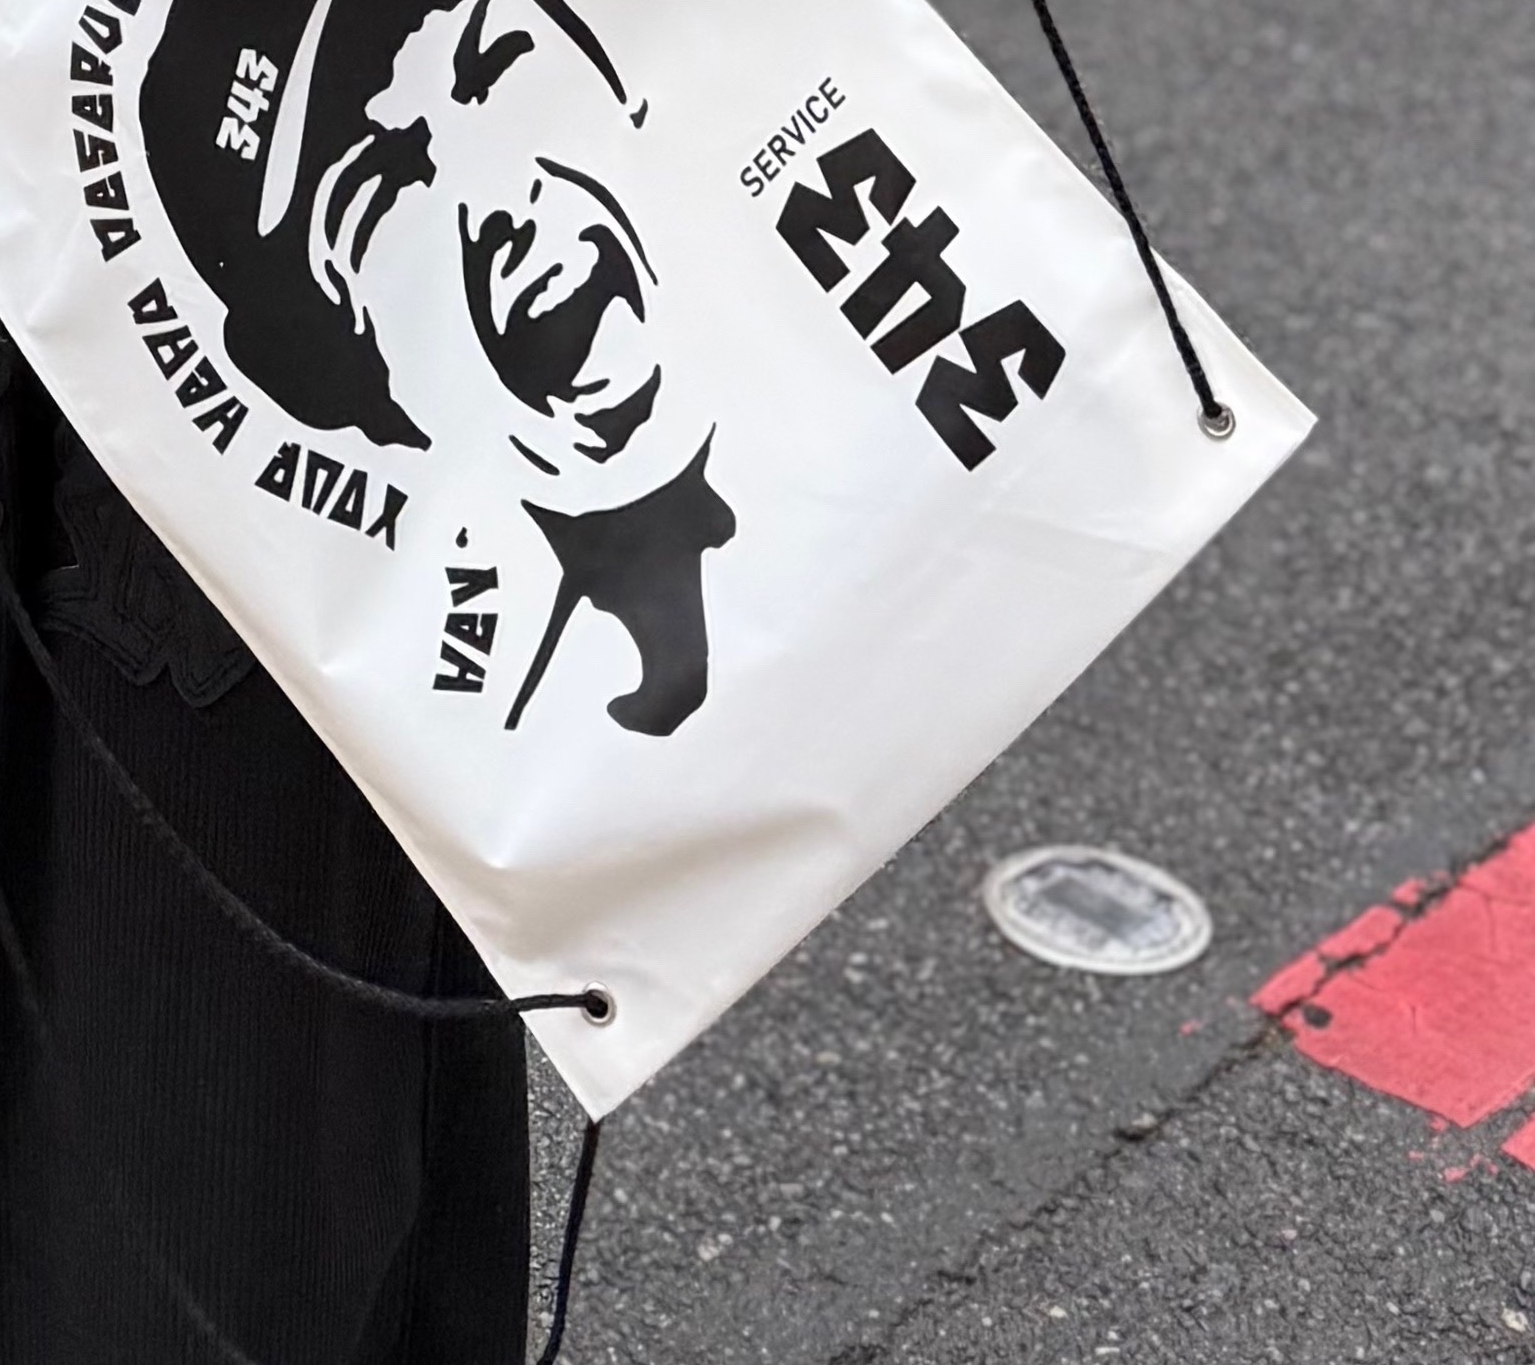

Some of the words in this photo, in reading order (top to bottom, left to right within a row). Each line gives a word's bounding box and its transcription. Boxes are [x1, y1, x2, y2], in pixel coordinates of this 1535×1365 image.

[216, 49, 279, 161] 343
[741, 77, 846, 197] SERVICE
[255, 442, 409, 551] YOUR
